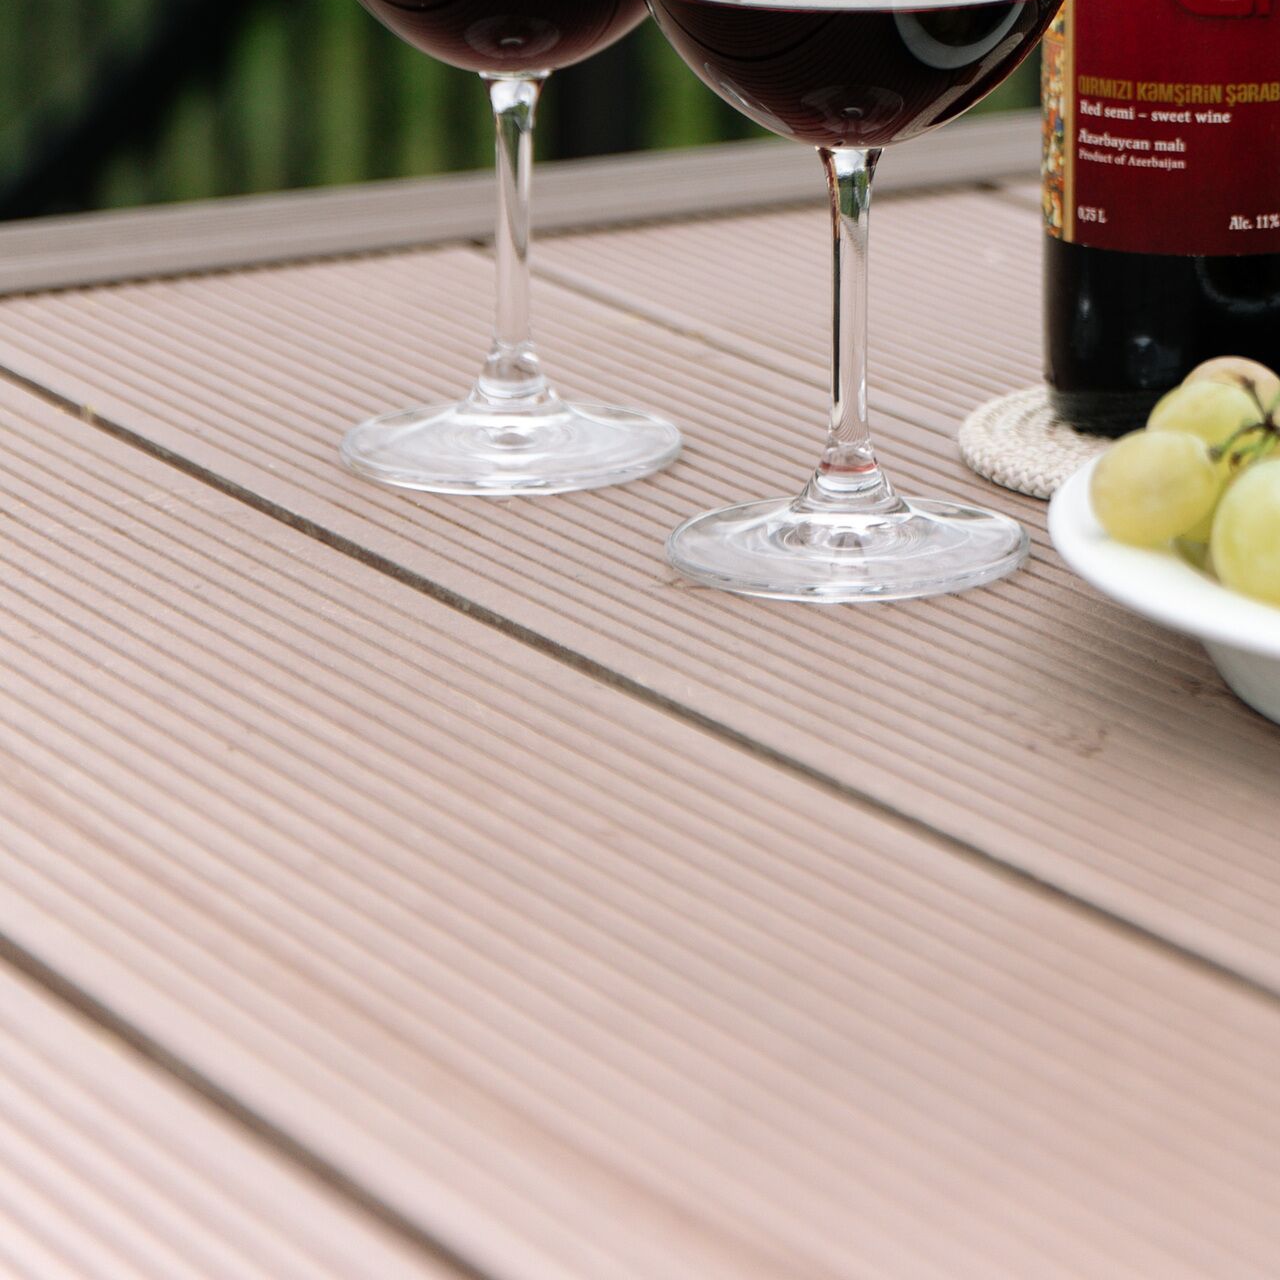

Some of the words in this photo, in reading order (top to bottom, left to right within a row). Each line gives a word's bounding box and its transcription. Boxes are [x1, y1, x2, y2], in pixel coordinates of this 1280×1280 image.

[1080, 99, 1101, 117] Red
[1104, 106, 1135, 120] semi
[1150, 110, 1192, 123] sweet
[1194, 109, 1232, 124] wine
[1078, 147, 1113, 164] Product
[1114, 153, 1127, 166] of
[1128, 155, 1186, 172] Azerbaijan
[1229, 215, 1253, 231] Alc.
